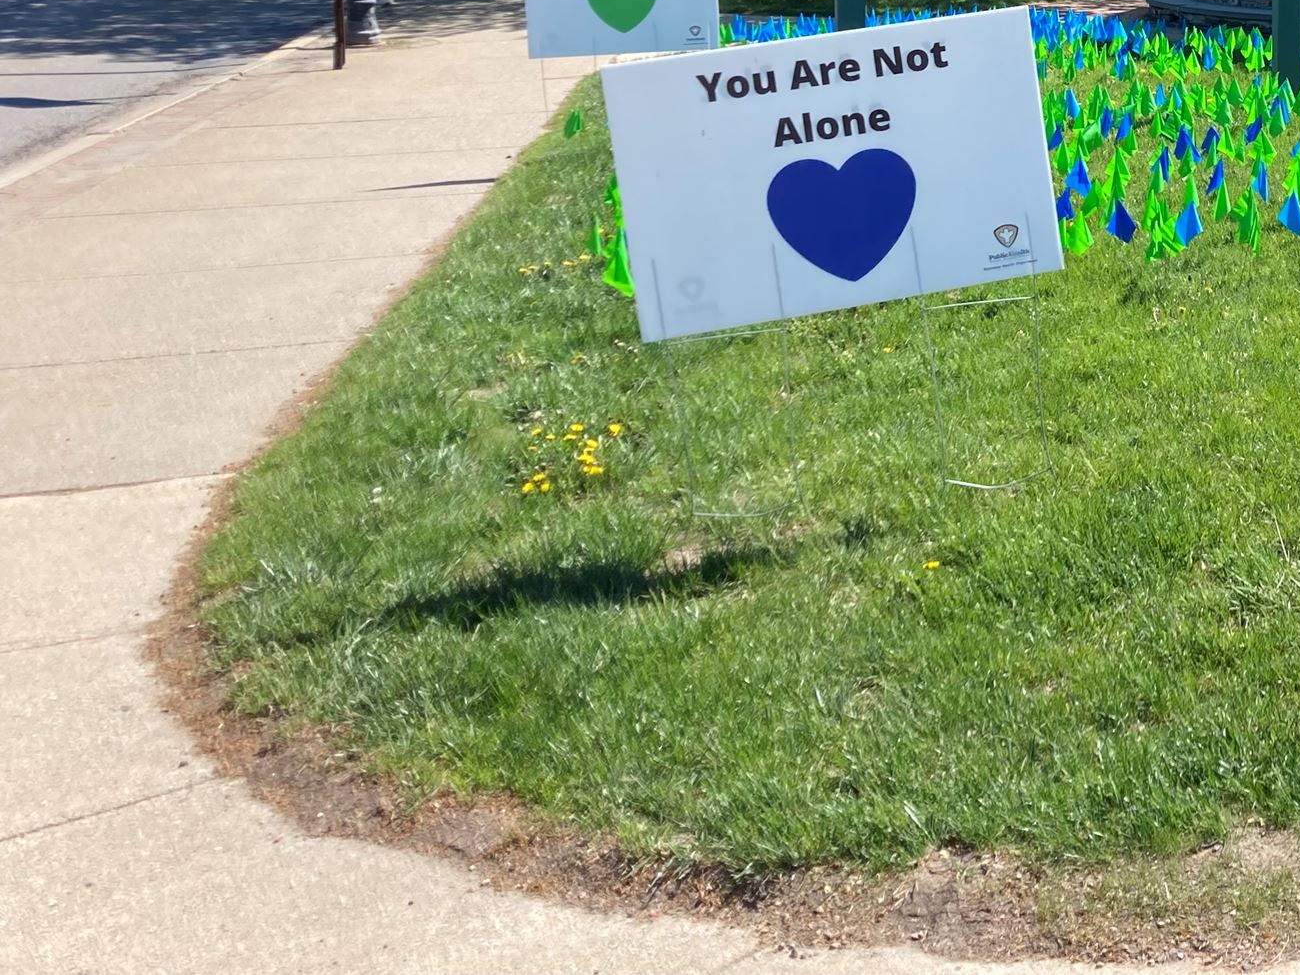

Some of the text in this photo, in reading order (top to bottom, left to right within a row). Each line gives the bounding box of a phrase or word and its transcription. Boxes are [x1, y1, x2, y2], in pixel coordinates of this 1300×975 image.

[696, 42, 949, 103] You Are Not
[774, 108, 891, 148] Alone
